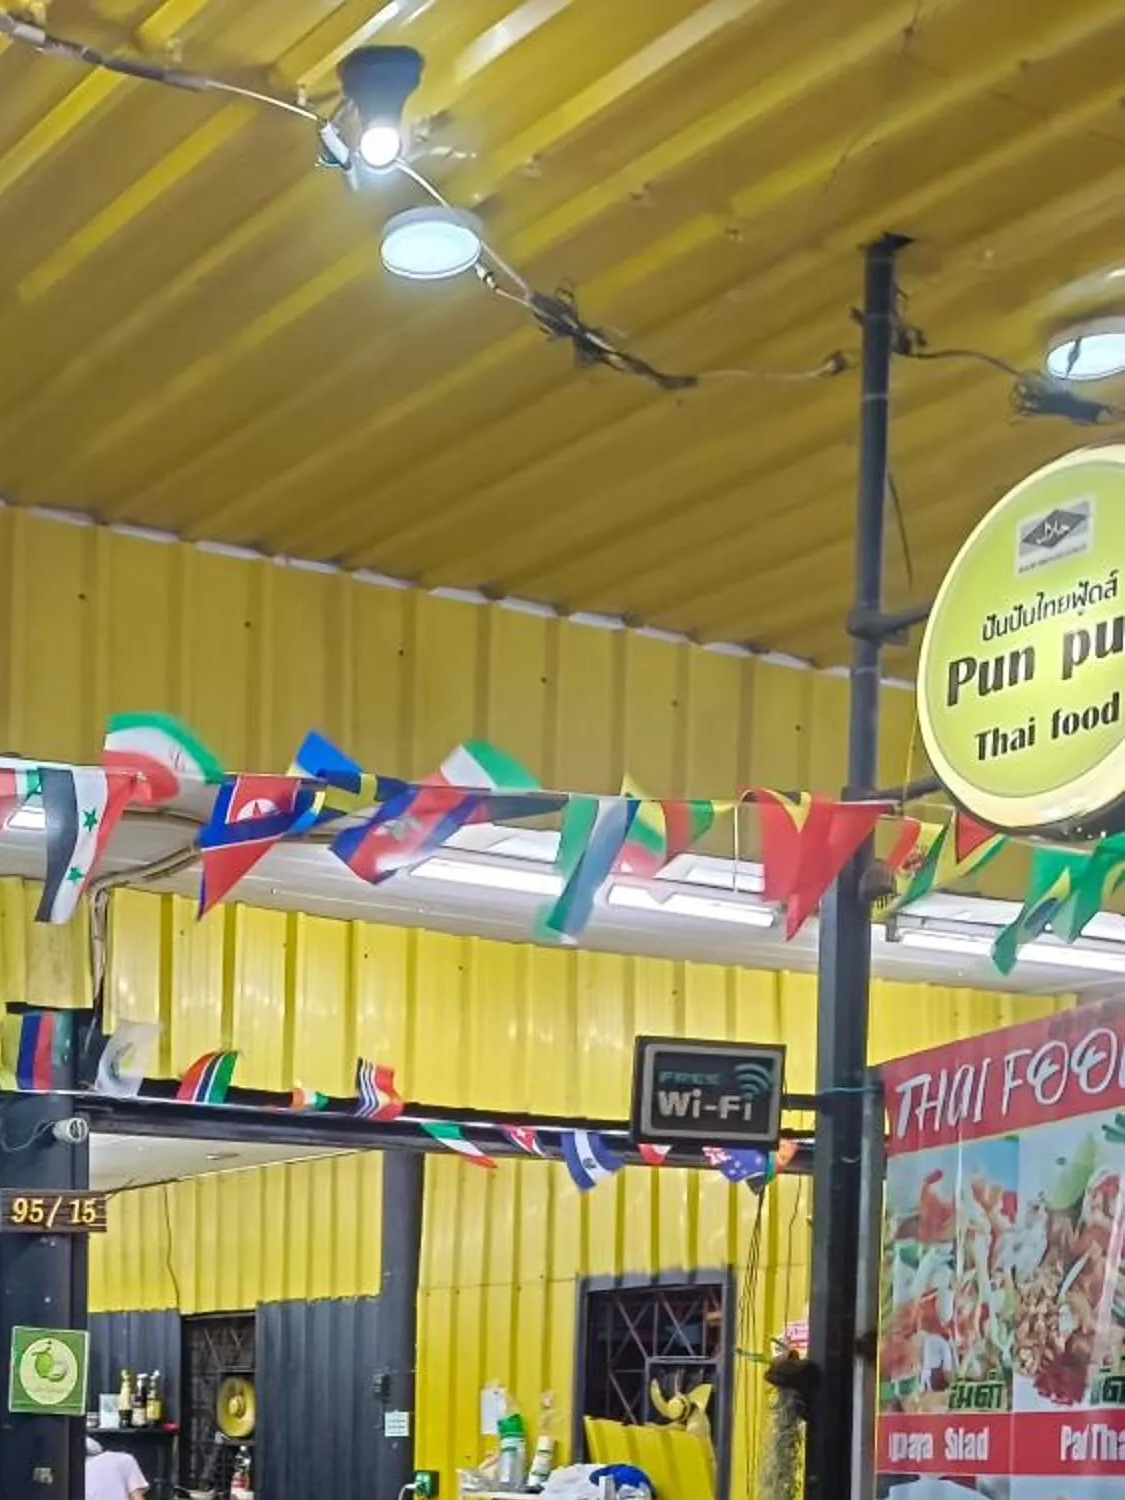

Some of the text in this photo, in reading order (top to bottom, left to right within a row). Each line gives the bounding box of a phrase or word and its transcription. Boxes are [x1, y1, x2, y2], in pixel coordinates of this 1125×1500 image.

[947, 646, 1036, 707] Pun
[975, 691, 1120, 761] Thai food
[658, 1071, 721, 1086] FREE
[1000, 1027, 1125, 1116] FOO
[657, 1088, 753, 1121] Wi-Fi
[10, 1196, 97, 1229] 95/15
